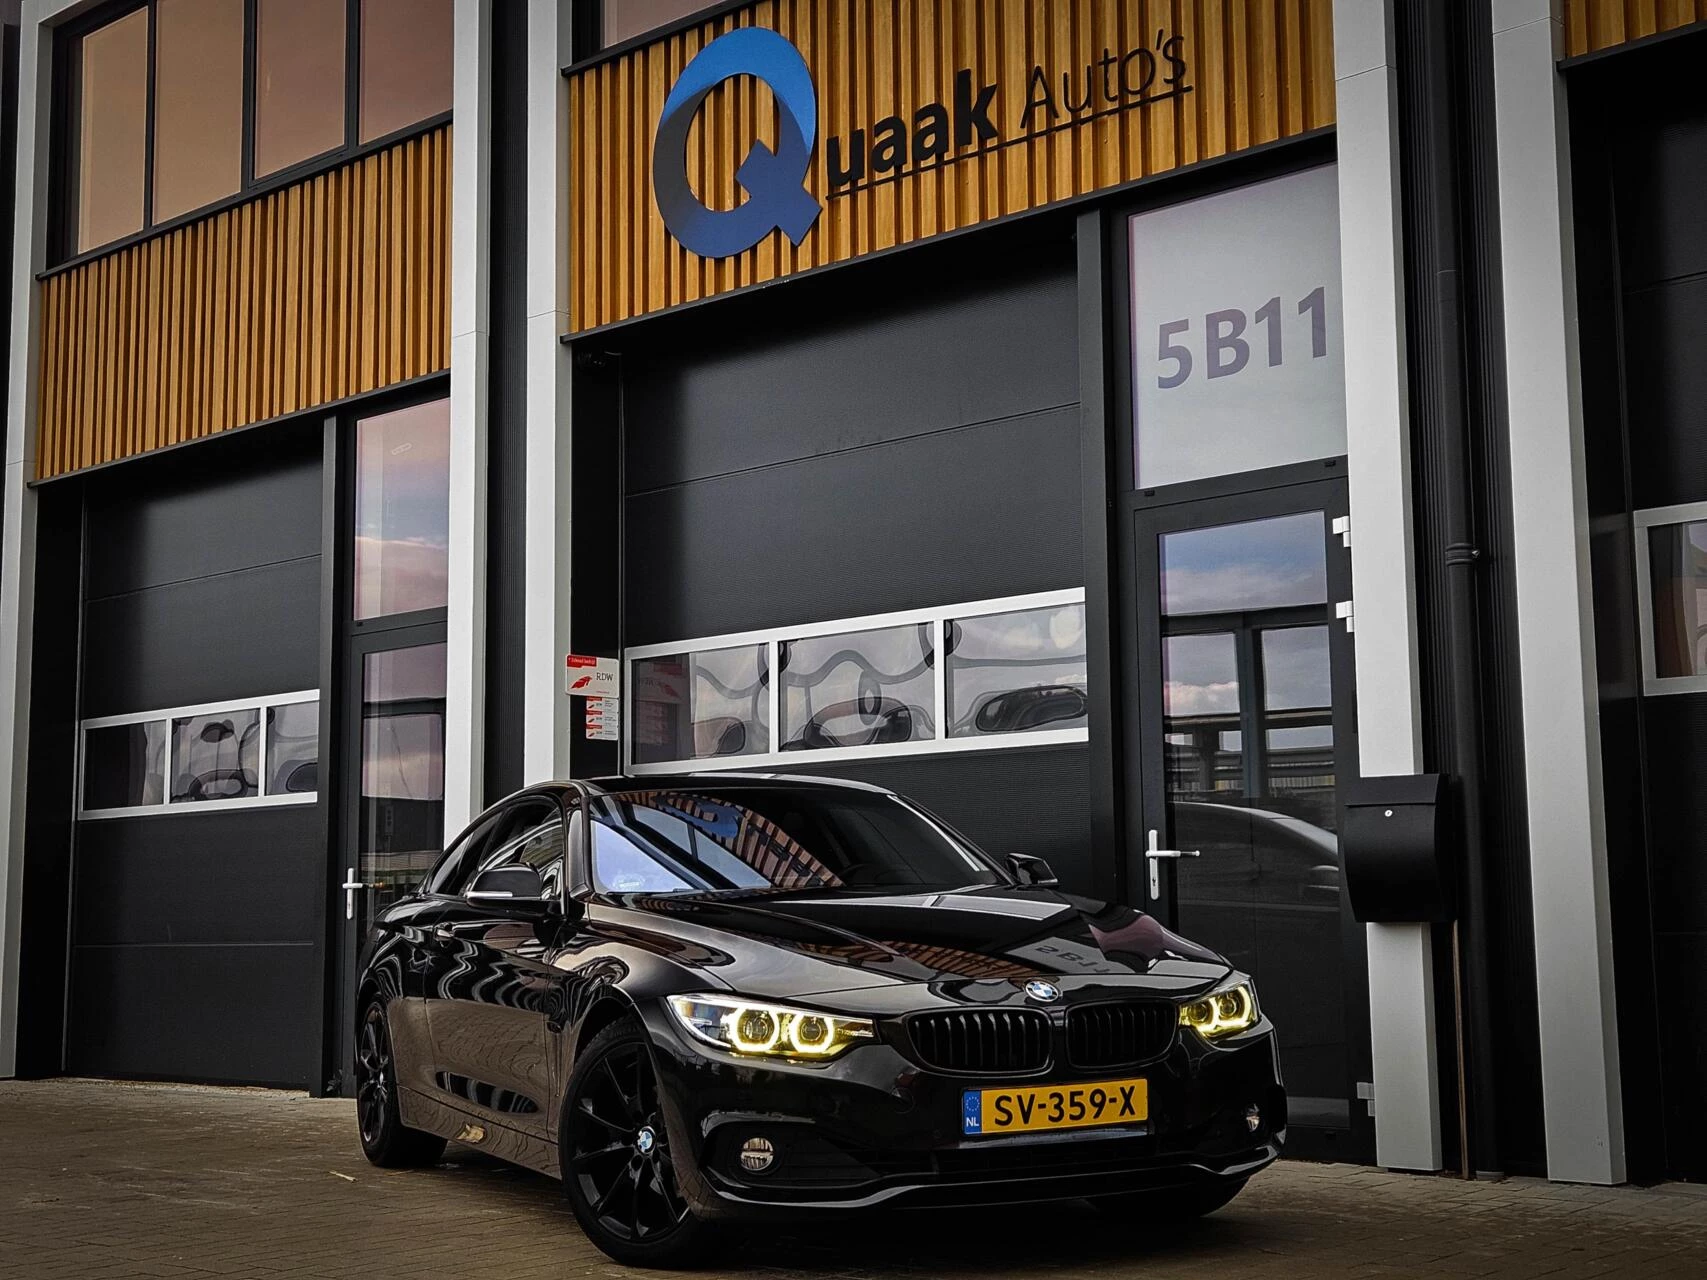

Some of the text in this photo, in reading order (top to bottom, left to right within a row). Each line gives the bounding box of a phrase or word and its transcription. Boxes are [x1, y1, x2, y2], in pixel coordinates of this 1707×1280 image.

[1019, 29, 1187, 128] Auto's
[1157, 286, 1327, 389] 5B11
[596, 672, 614, 682] RDW
[966, 1117, 980, 1128] NL
[994, 1085, 1136, 1127] SV-359-X
